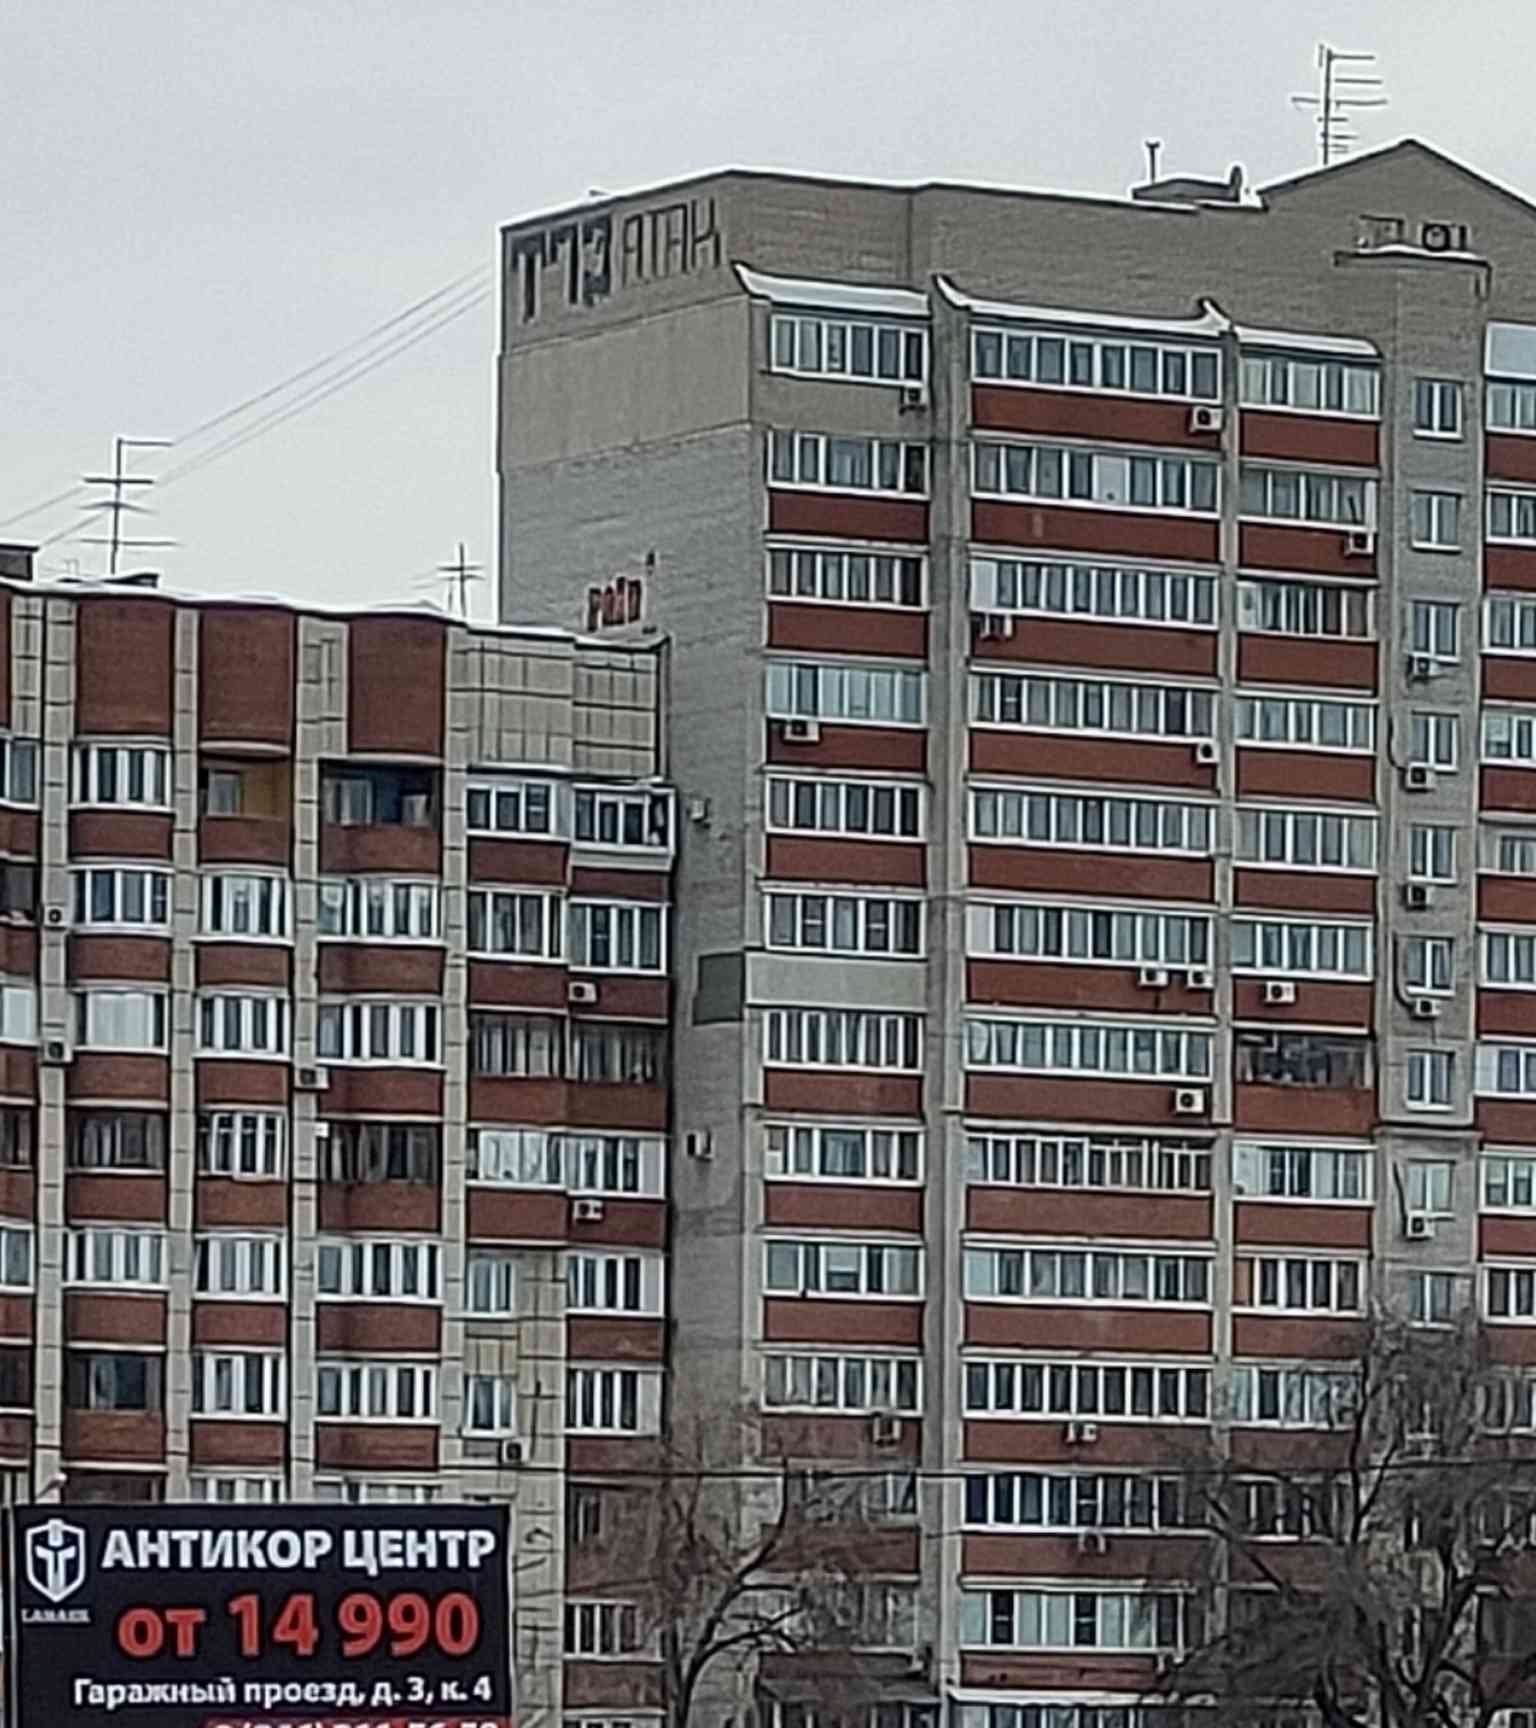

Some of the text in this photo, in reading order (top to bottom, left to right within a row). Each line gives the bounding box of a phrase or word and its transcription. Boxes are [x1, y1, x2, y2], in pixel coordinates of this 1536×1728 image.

[101, 1529, 496, 1577] АНТИКОР ЦЕНТР
[118, 1592, 479, 1658] от 14 990
[73, 1675, 492, 1711] Гаражный проезд, д. 3, к. 4
